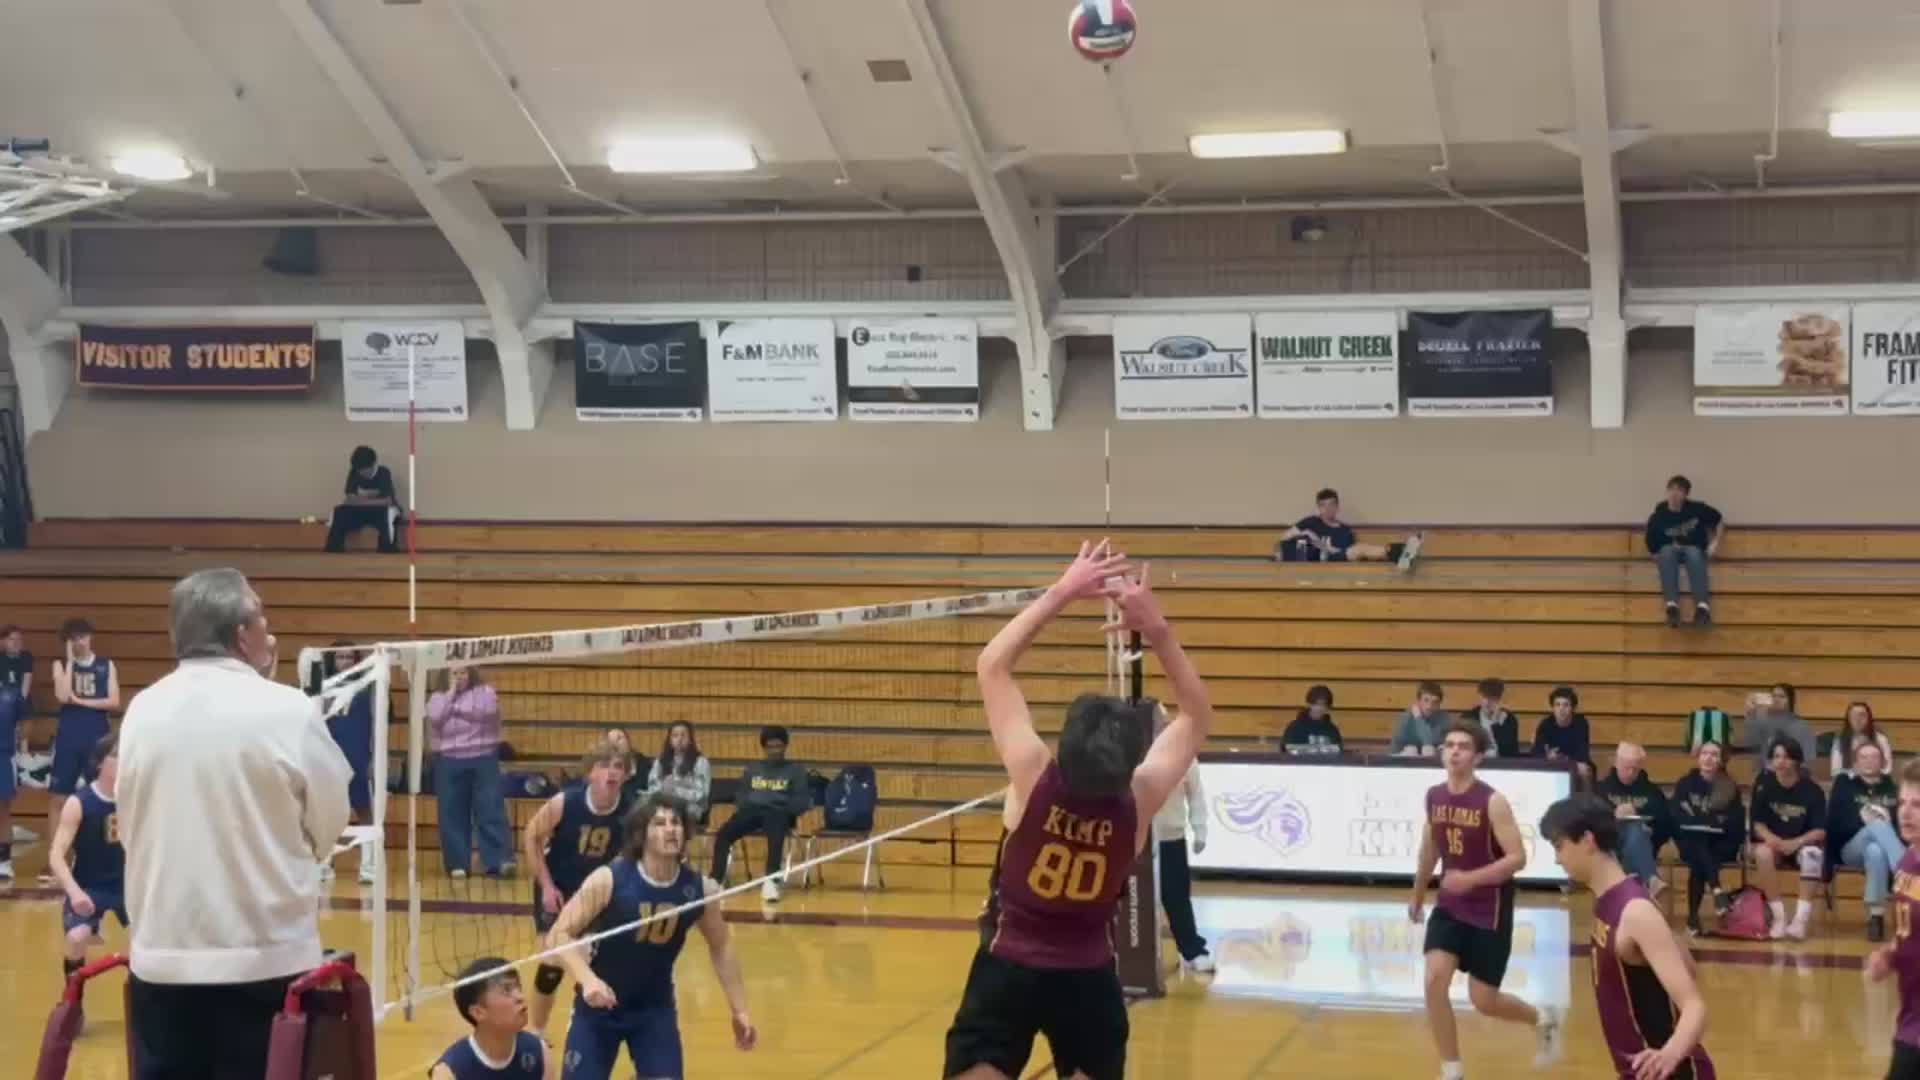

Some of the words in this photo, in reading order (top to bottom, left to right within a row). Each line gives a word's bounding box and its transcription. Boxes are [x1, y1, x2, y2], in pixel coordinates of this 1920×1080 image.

[82, 341, 172, 369] VISITOR
[186, 343, 311, 370] STUDENTS
[585, 342, 687, 374] BASE
[1260, 335, 1333, 359] WALNUT
[1339, 335, 1393, 358] CREEK
[1027, 843, 1107, 900] 80
[635, 902, 679, 944] 10
